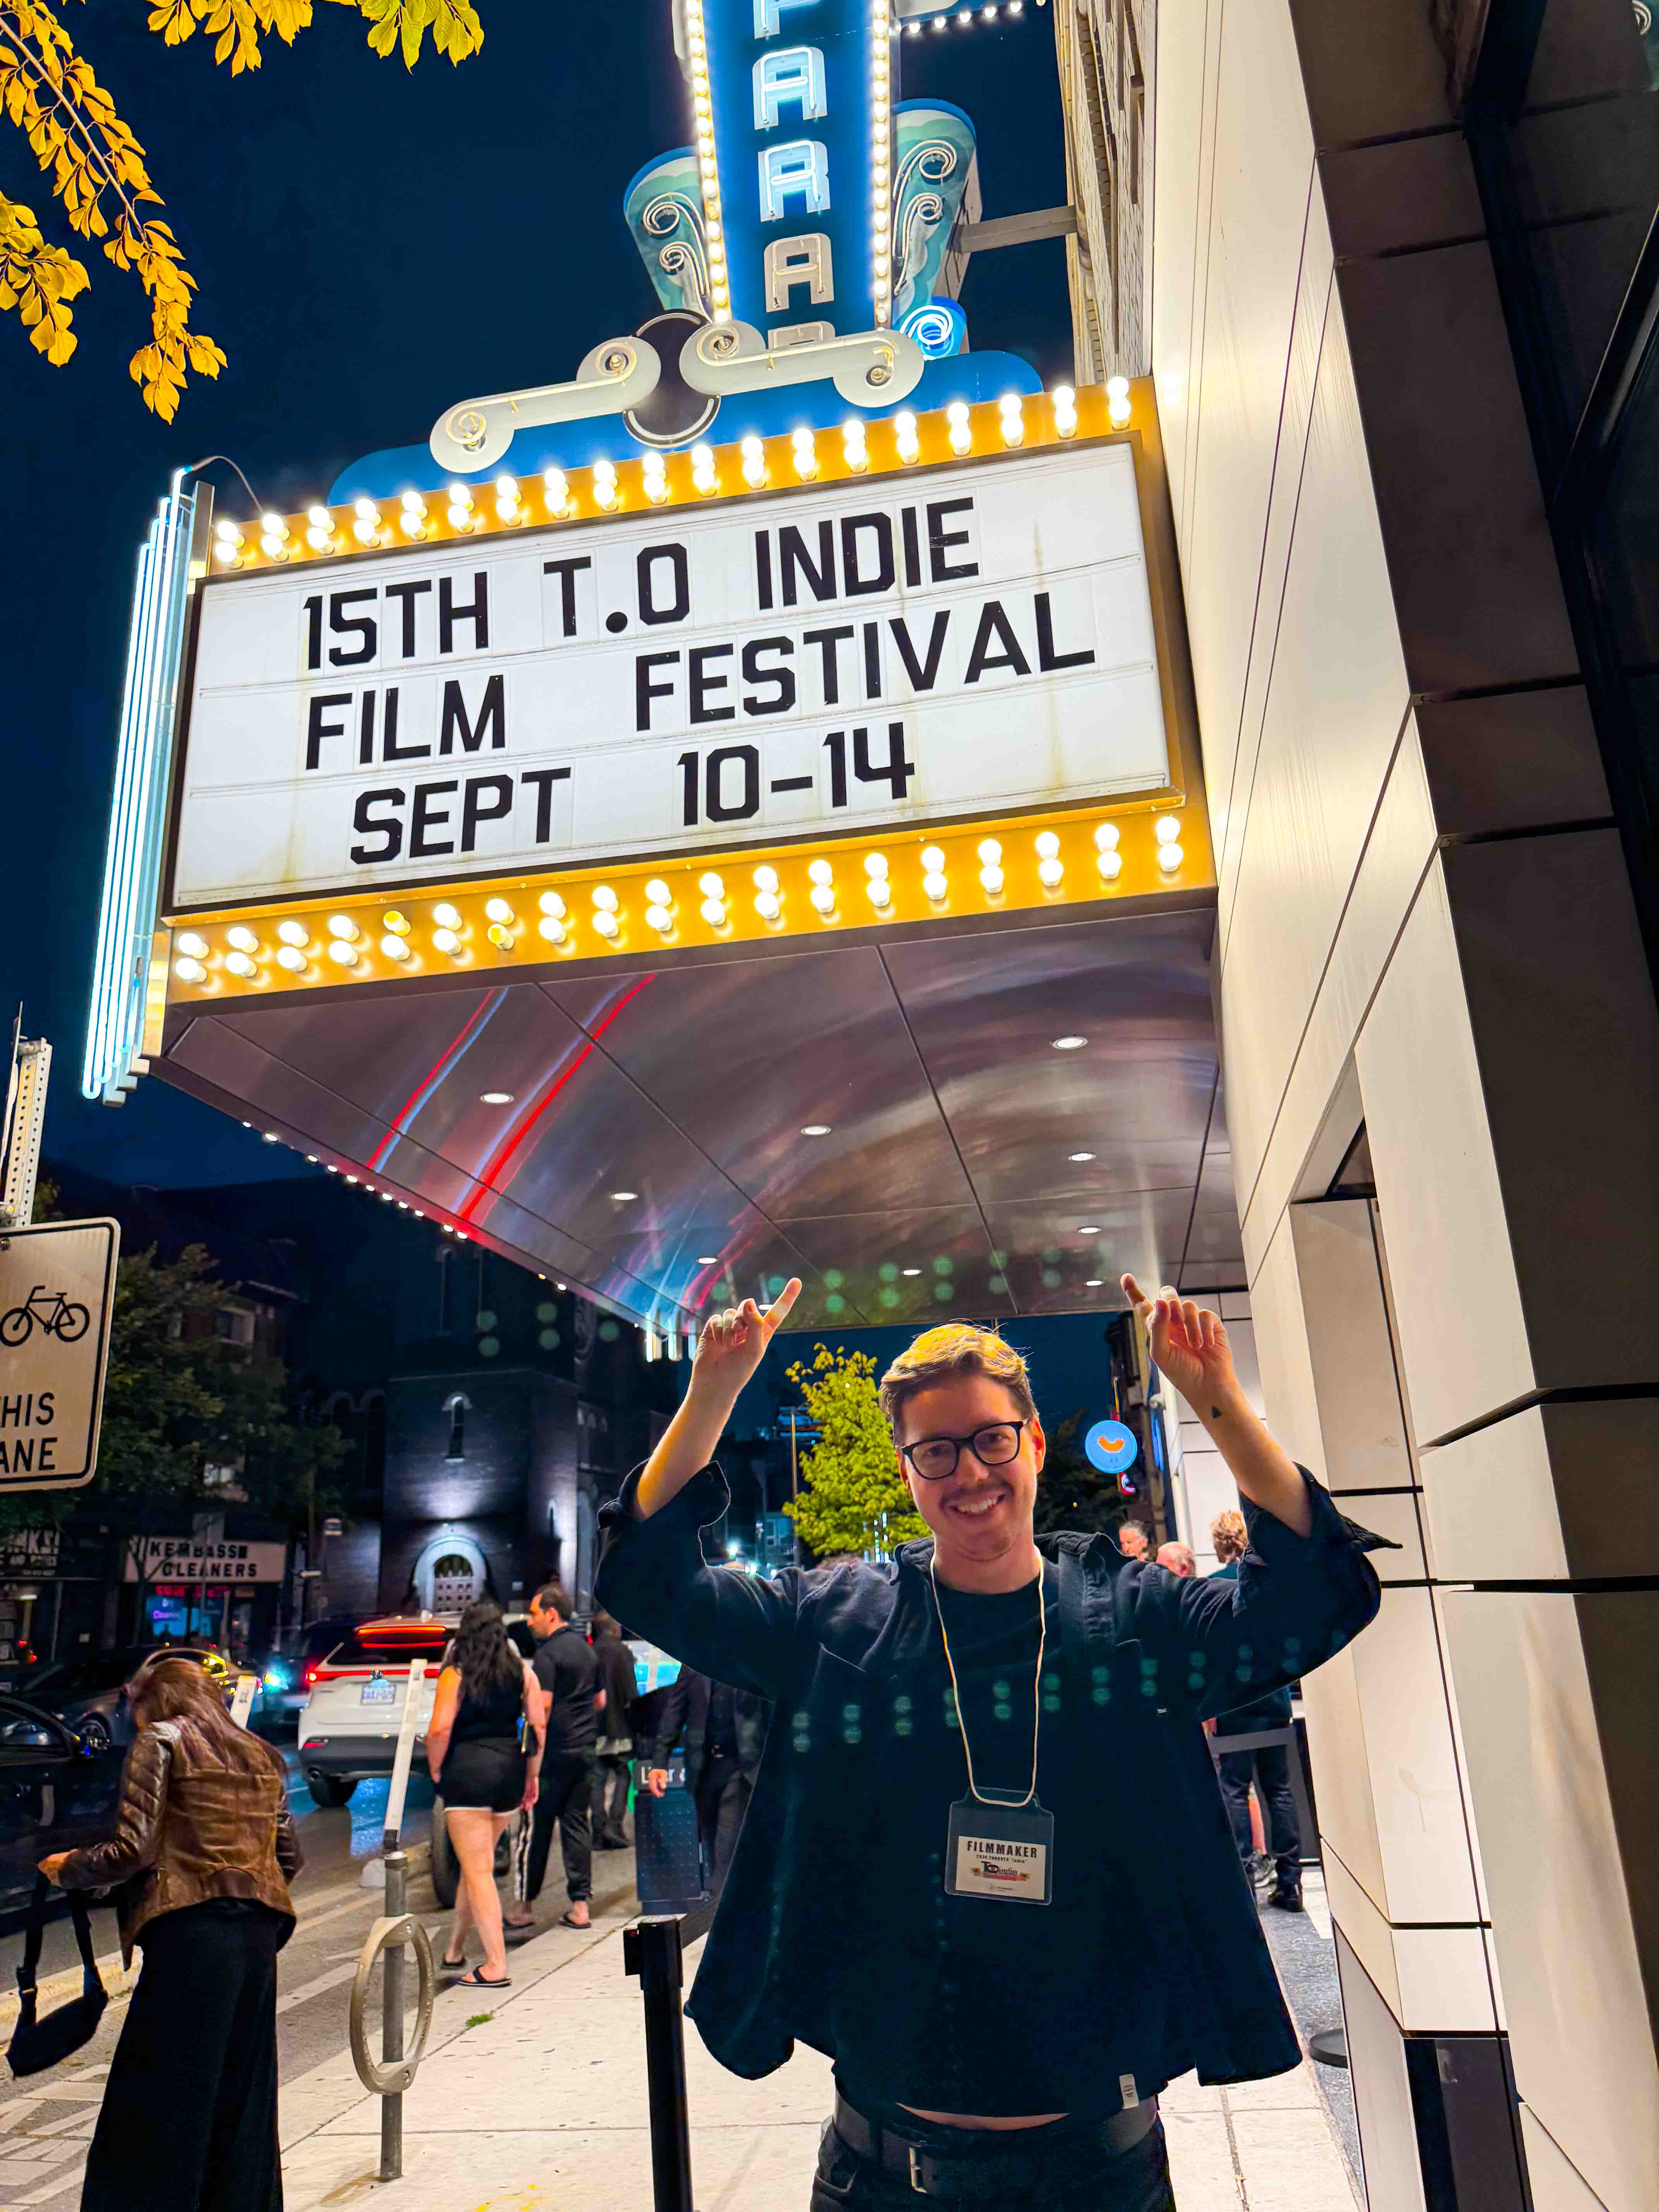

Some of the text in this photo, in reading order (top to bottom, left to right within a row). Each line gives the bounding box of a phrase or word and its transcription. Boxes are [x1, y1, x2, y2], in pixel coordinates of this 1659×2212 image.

[303, 496, 979, 670] 15TH T.O INDIE
[306, 592, 1096, 770] FILM FESTIVAL
[350, 721, 915, 865] SEPT 10-14
[0, 1392, 55, 1428] HIS
[0, 1437, 58, 1473] ANE
[967, 1841, 1037, 1858] FILMMAKER
